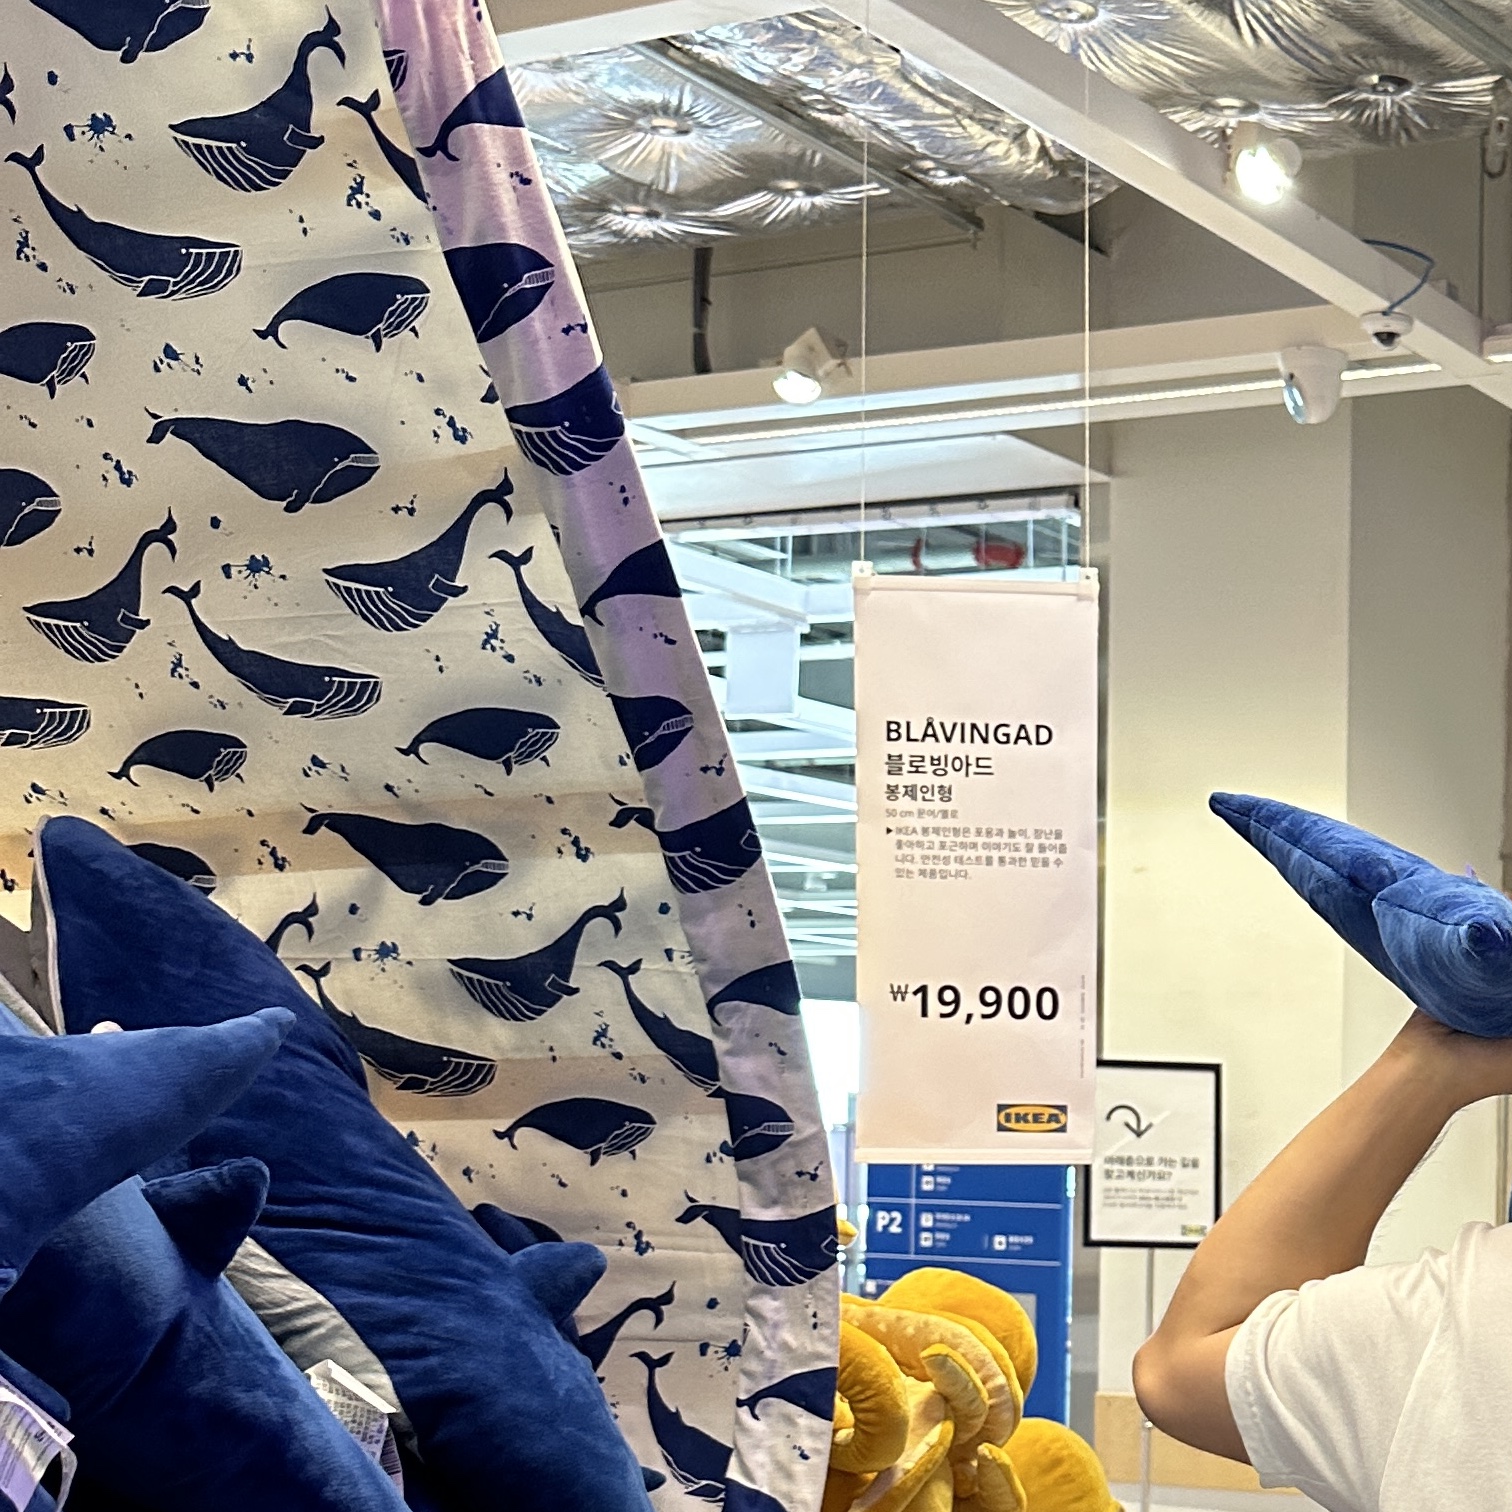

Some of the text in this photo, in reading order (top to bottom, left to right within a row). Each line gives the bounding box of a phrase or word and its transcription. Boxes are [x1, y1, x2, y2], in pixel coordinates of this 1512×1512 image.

[886, 717, 1054, 746] BLÅVINGAD
[884, 753, 995, 777] 블로빙아드
[884, 784, 953, 802] 봉제인형
[885, 808, 898, 818] 50
[899, 810, 915, 818] cm
[895, 827, 918, 836] IKEA
[1053, 857, 1064, 868] 수
[889, 983, 1060, 1025] ₩19,900
[1003, 1112, 1063, 1125] IKEA
[876, 1209, 903, 1234] P2
